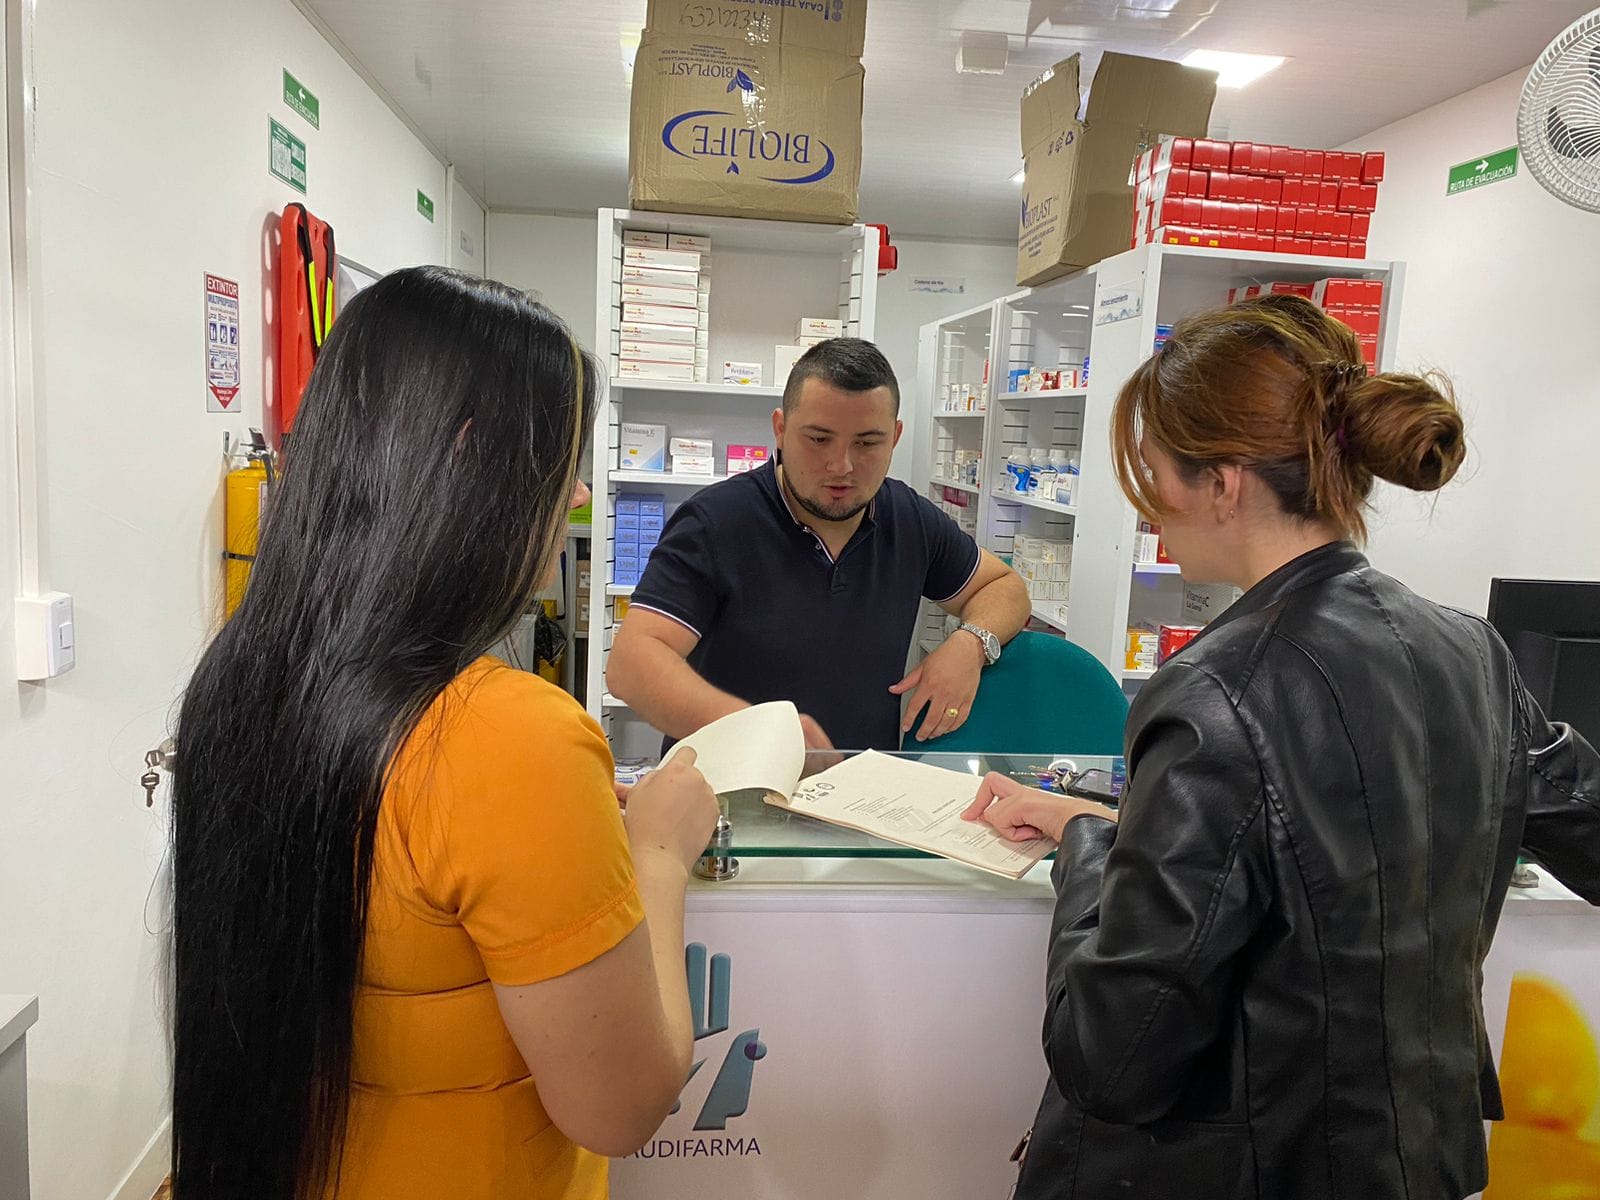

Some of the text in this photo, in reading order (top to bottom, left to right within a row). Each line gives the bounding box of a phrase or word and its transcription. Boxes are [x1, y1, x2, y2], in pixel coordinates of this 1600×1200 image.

[800, 1, 824, 12] CAJA
[669, 62, 734, 78] BIOPLAST
[692, 125, 811, 163] BIOLIFE
[1465, 176, 1474, 187] DE
[207, 277, 238, 297] EXTINTOR
